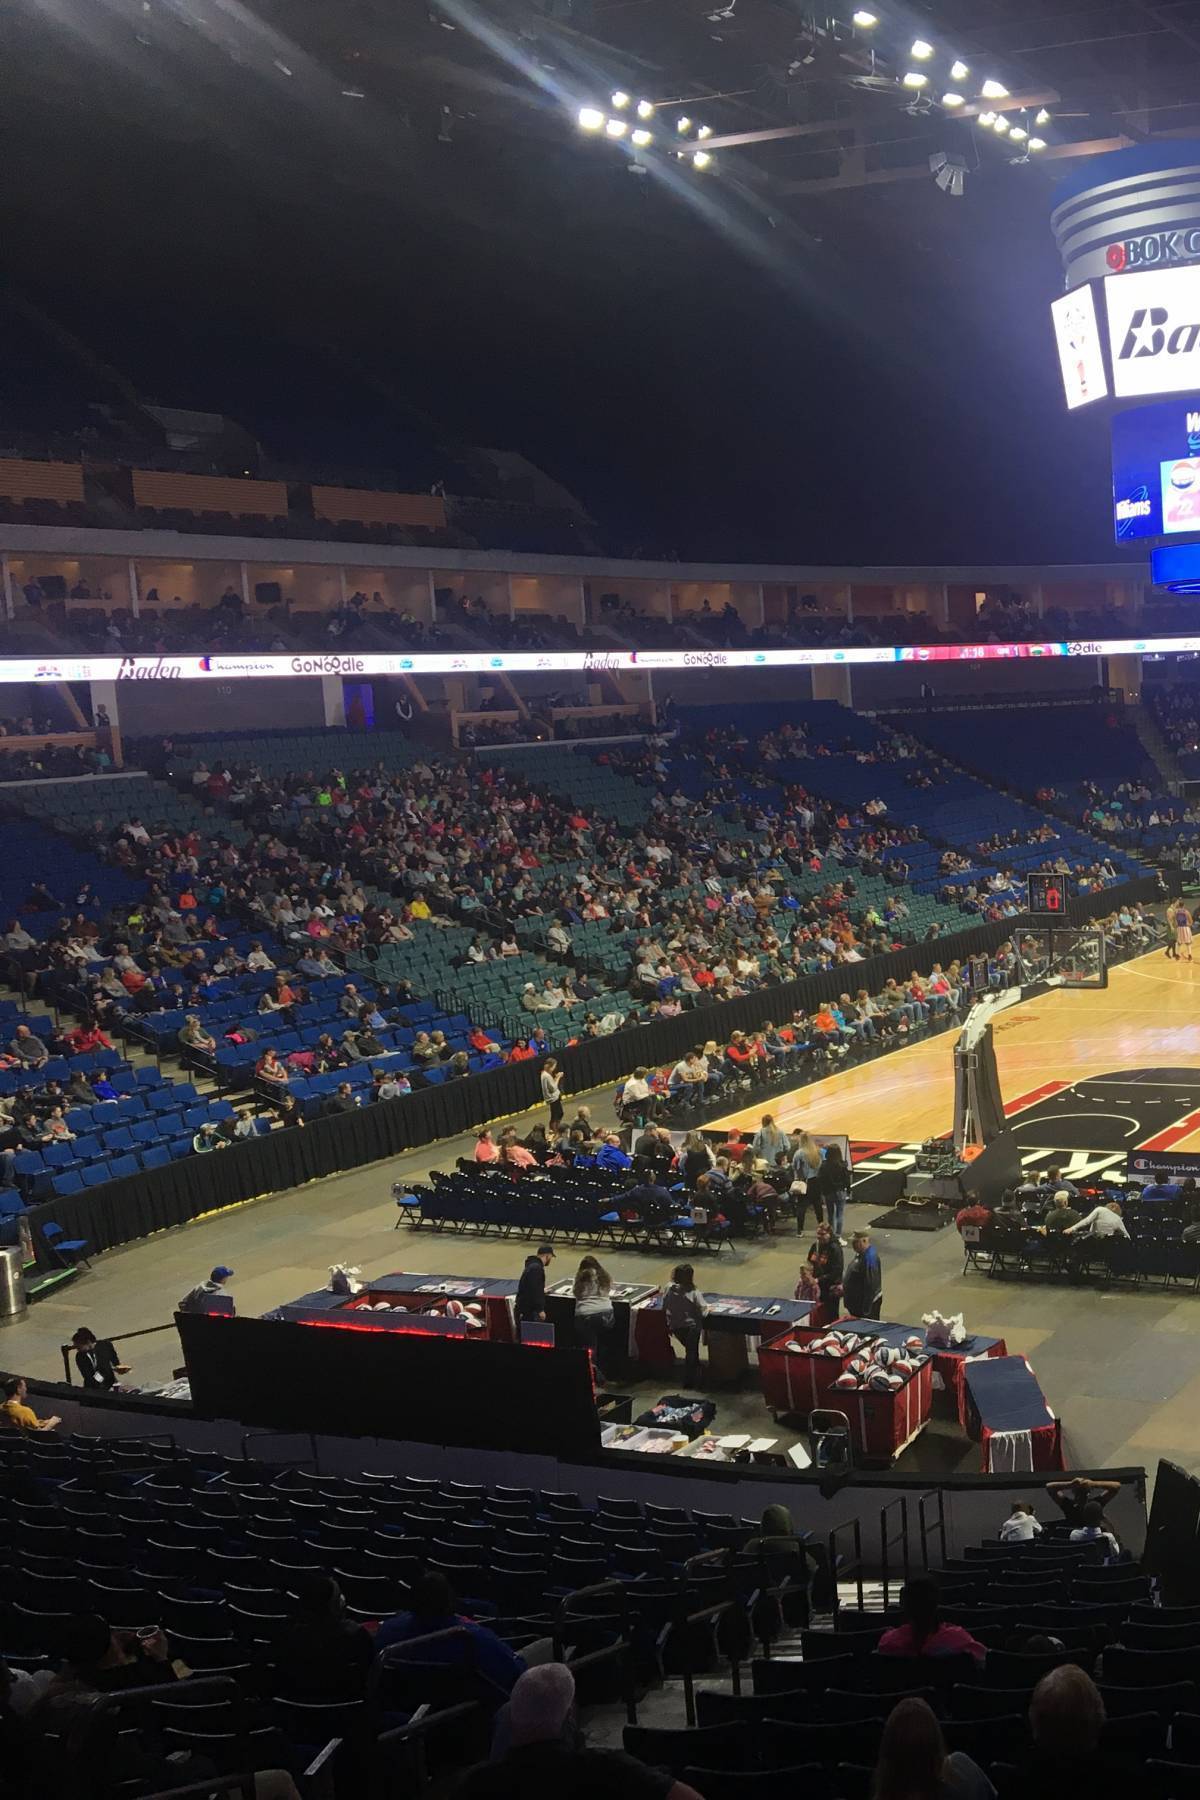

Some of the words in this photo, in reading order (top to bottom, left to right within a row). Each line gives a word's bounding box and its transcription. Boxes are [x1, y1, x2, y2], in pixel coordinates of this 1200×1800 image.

[1124, 231, 1180, 266] BOK
[117, 656, 182, 680] Baden
[291, 656, 364, 676] GoNoodle
[683, 652, 729, 667] GoNoodle
[1133, 1158, 1200, 1175] Champion
